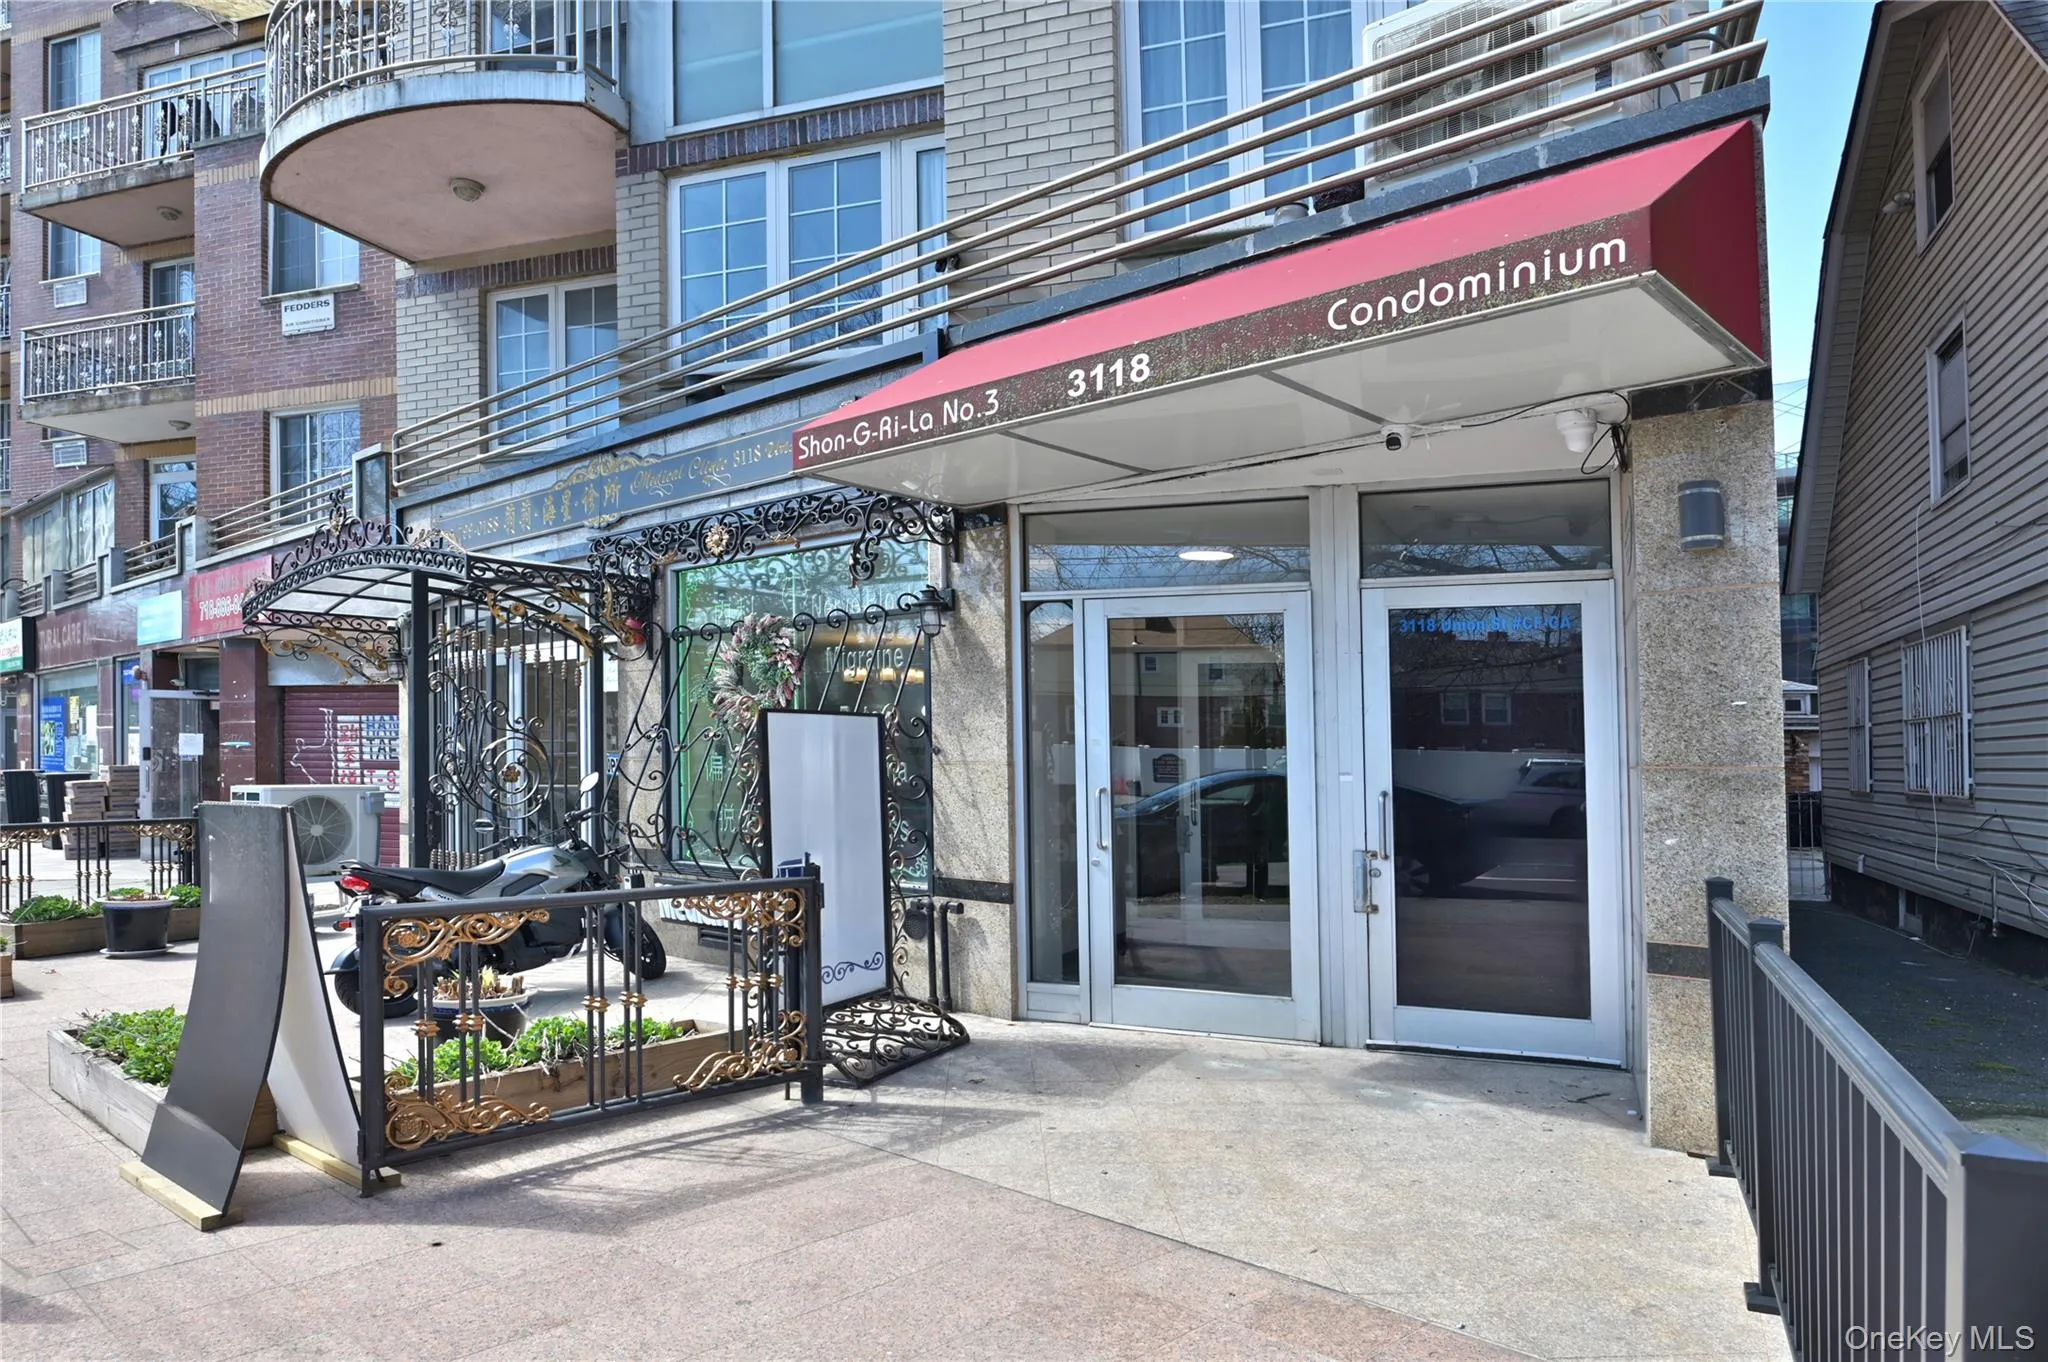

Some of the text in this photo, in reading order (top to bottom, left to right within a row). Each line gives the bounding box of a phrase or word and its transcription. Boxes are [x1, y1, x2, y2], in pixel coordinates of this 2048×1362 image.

[283, 299, 330, 312] FEDDERS
[1327, 237, 1626, 331] Condominium
[1067, 353, 1151, 399] 3118
[798, 388, 1000, 460] Shon-G-Ri-La No.3
[630, 464, 682, 497] Medical
[688, 456, 731, 486] Clinic
[733, 444, 761, 467] 3118
[1400, 616, 1436, 633] 3118
[1440, 617, 1488, 633] Union
[825, 645, 905, 677] Migraine
